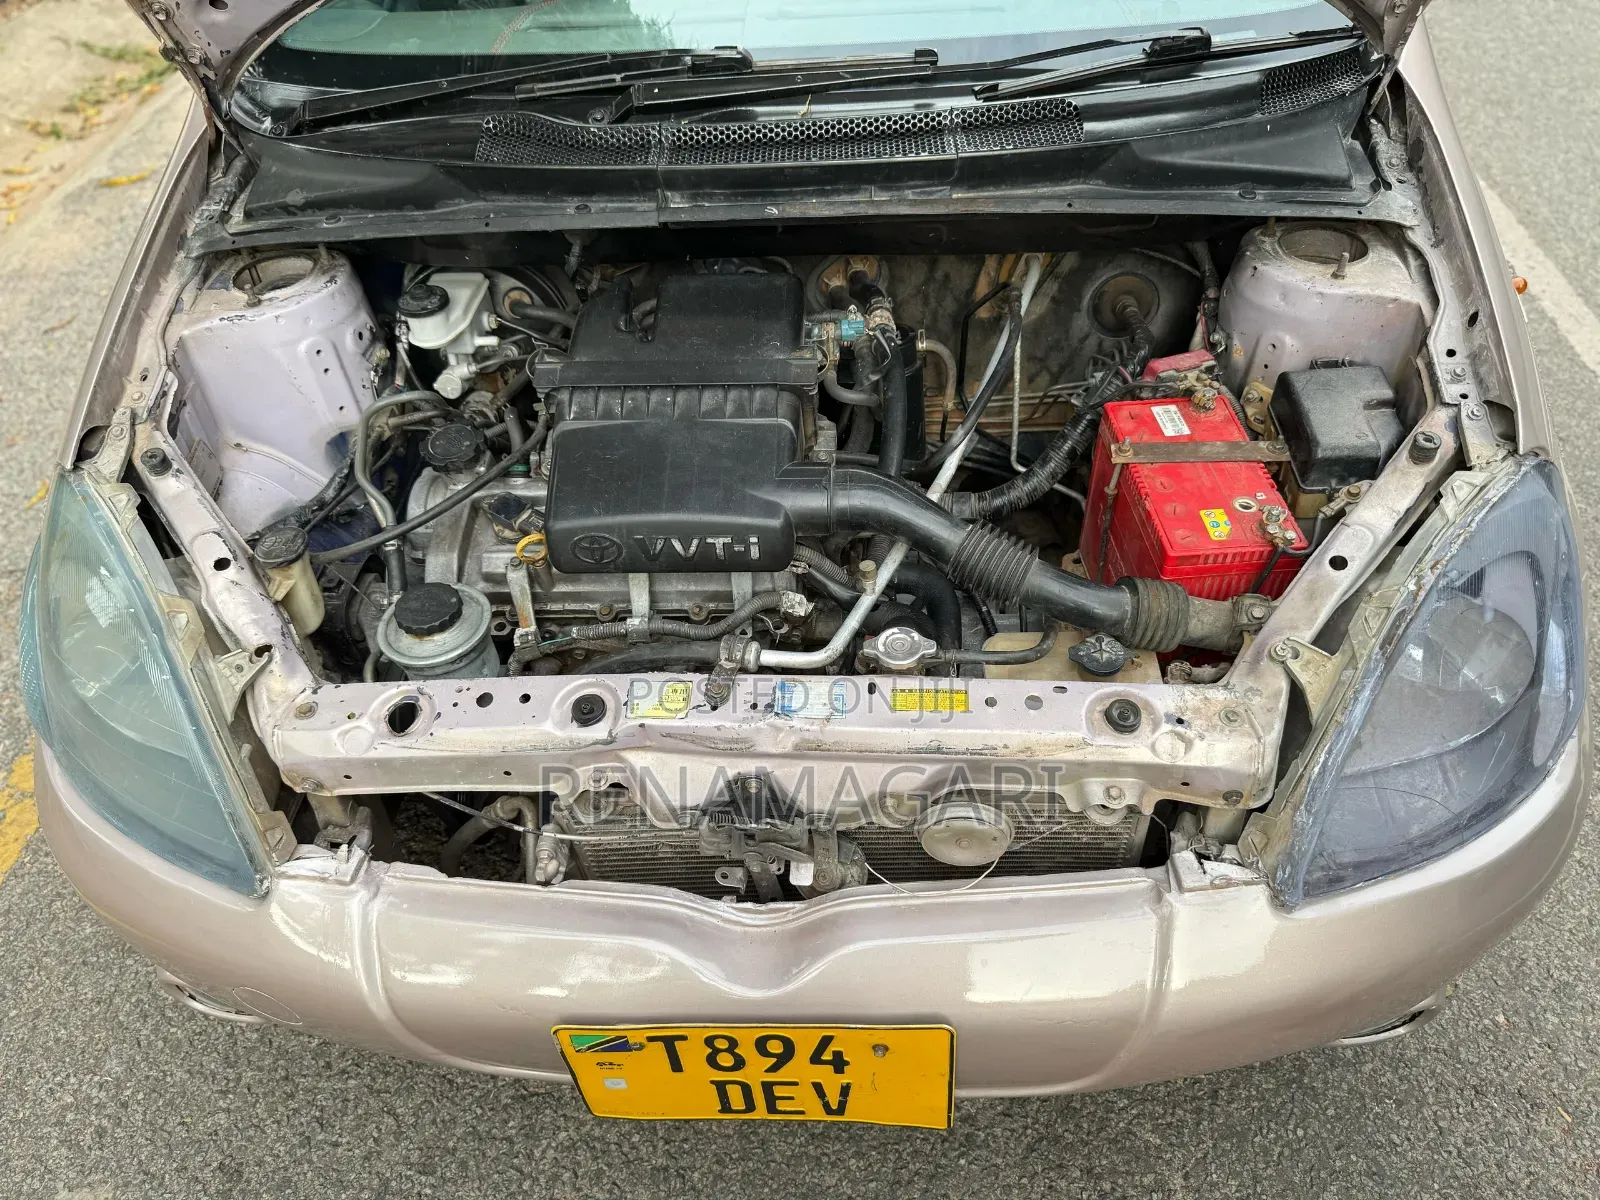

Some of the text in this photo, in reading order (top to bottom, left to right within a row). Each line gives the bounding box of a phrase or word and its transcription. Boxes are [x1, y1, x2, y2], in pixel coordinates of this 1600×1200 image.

[633, 535, 761, 562] VVT-i
[646, 1034, 850, 1074] T894
[709, 1079, 851, 1116] DEV
